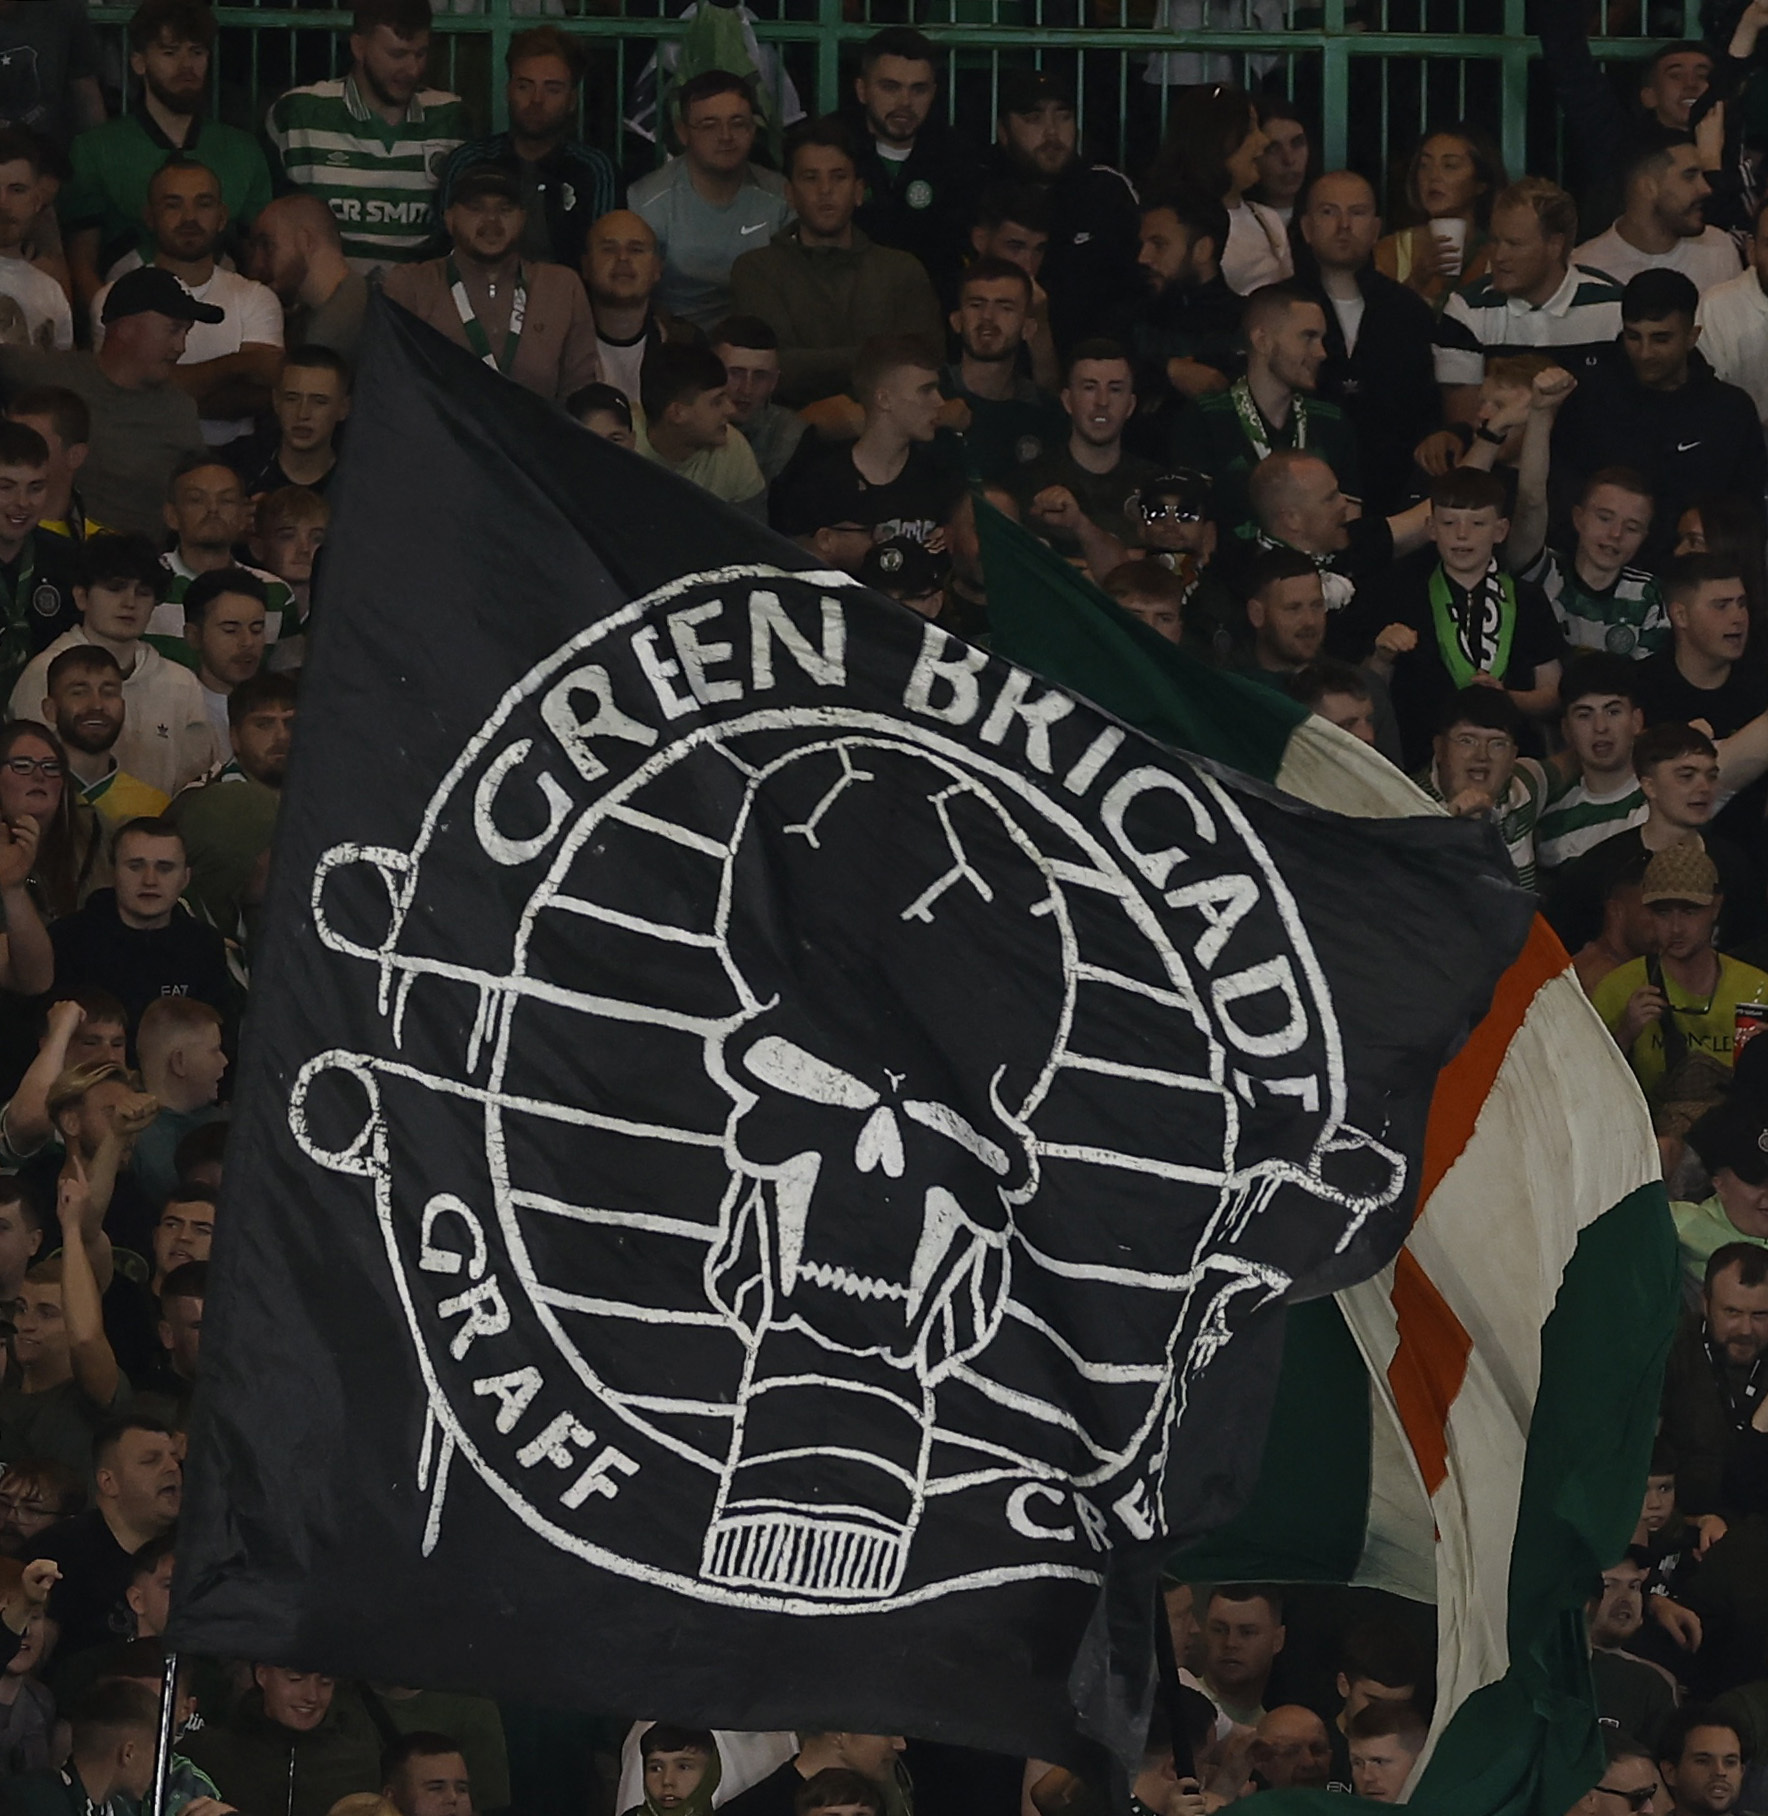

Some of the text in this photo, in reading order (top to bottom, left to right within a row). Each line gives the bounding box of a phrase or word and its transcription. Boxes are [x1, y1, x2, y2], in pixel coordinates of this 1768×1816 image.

[473, 589, 1320, 1116] GREEN BRIGADE
[418, 1191, 641, 1510] GRAFF
